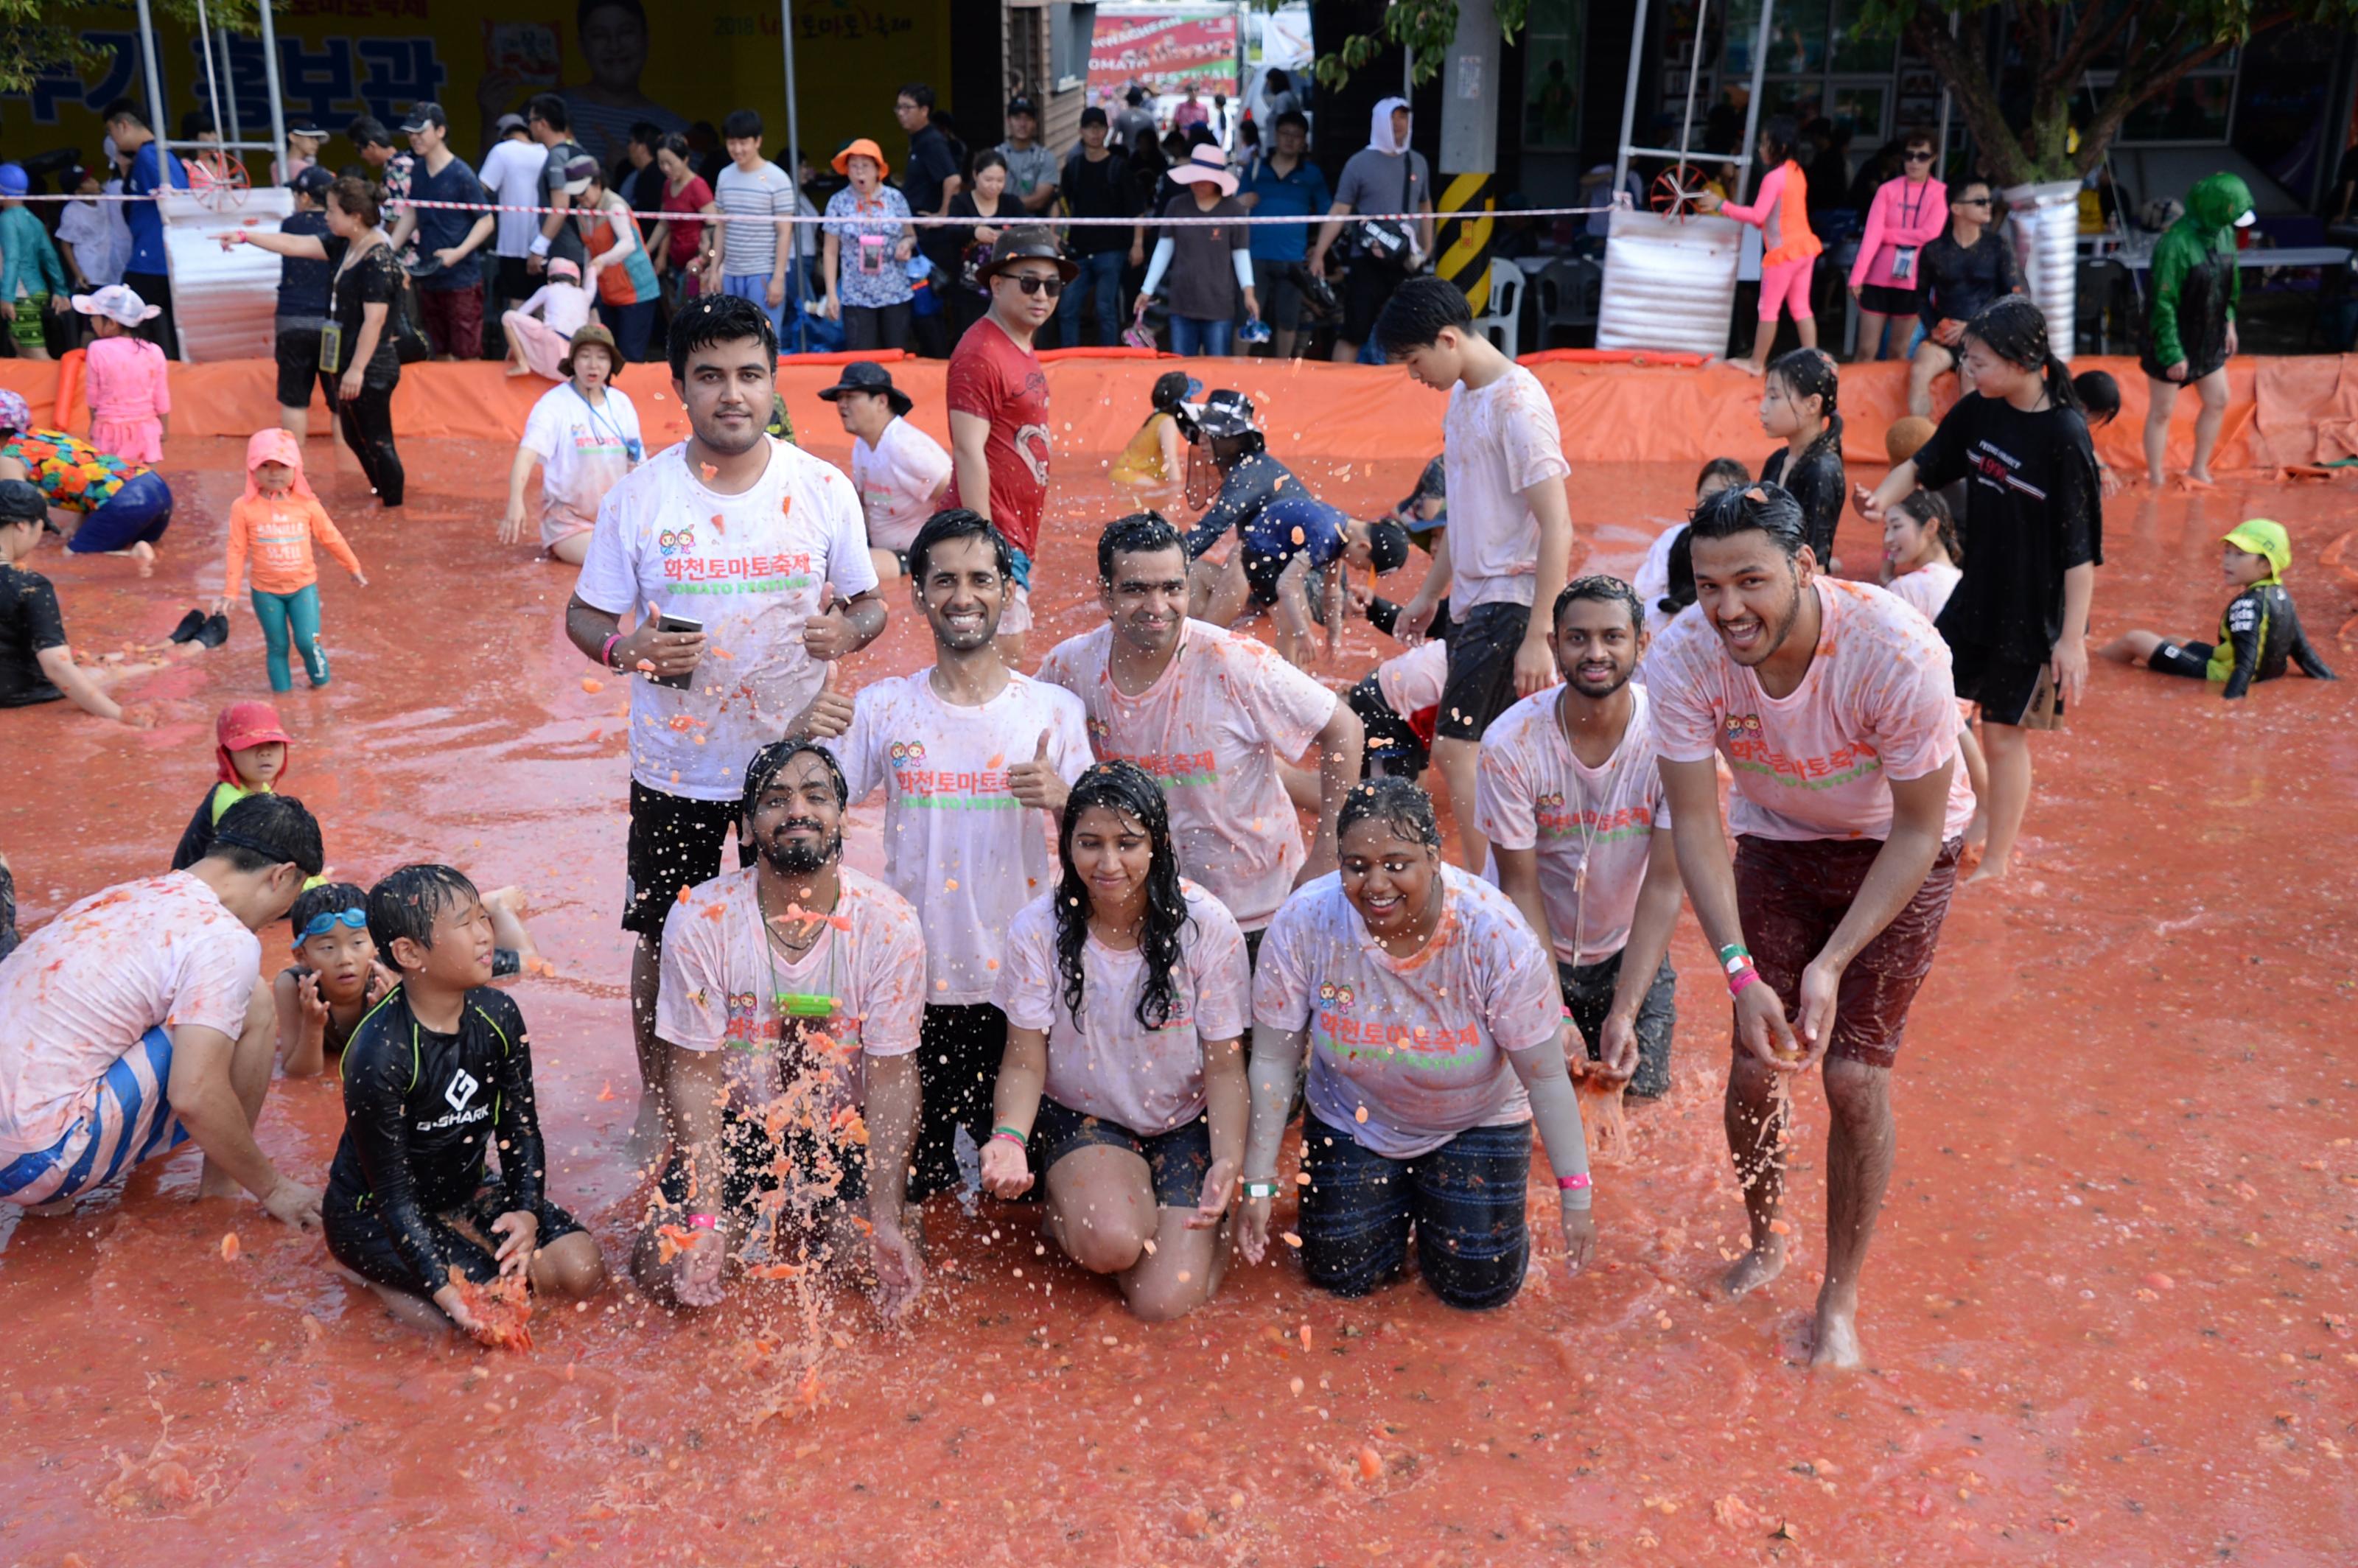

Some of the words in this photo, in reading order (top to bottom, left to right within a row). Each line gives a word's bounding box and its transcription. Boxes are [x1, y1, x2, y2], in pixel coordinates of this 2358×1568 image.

[1087, 57, 1150, 70] OMATO
[664, 553, 811, 581] 화천토마토축제
[666, 582, 733, 595] TOMATO
